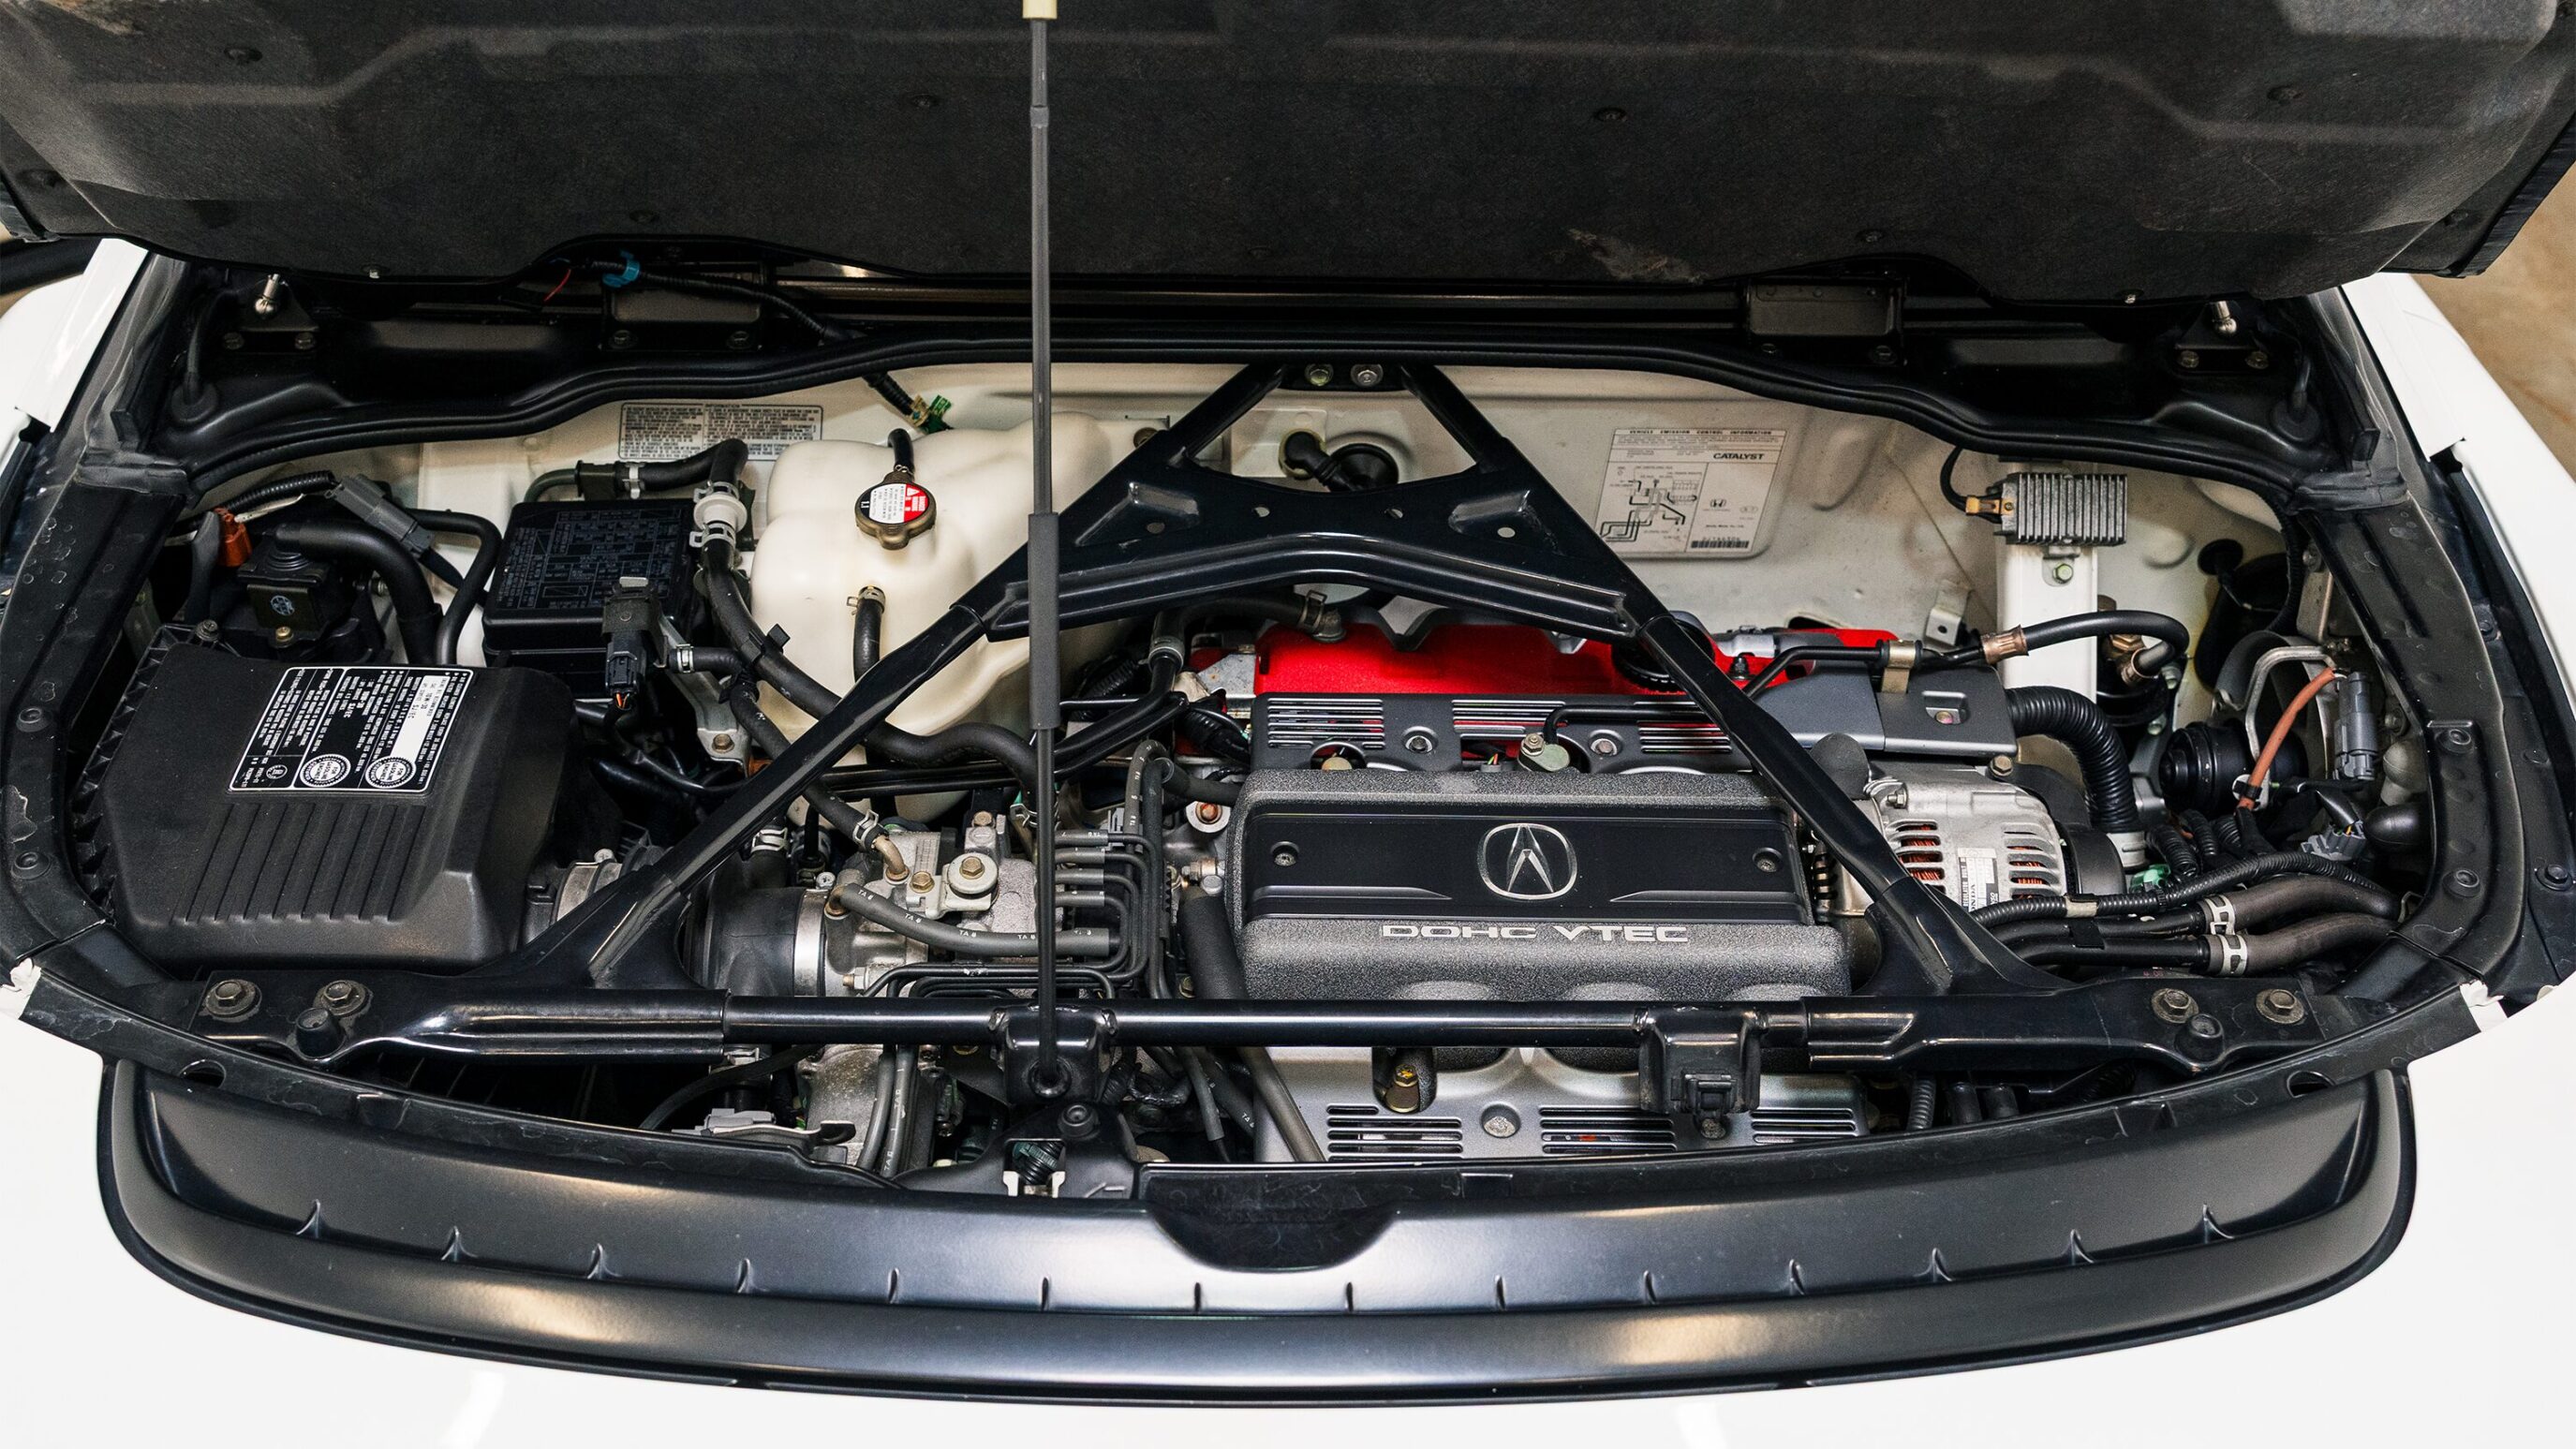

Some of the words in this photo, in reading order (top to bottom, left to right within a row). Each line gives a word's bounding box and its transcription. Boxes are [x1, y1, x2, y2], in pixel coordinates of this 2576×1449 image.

[1713, 452, 1766, 461] CATALYST
[378, 763, 390, 779] ENGINES
[386, 762, 398, 779] GASOLINE
[1383, 924, 1537, 939] DOHC
[1552, 924, 1689, 942] VTEC
